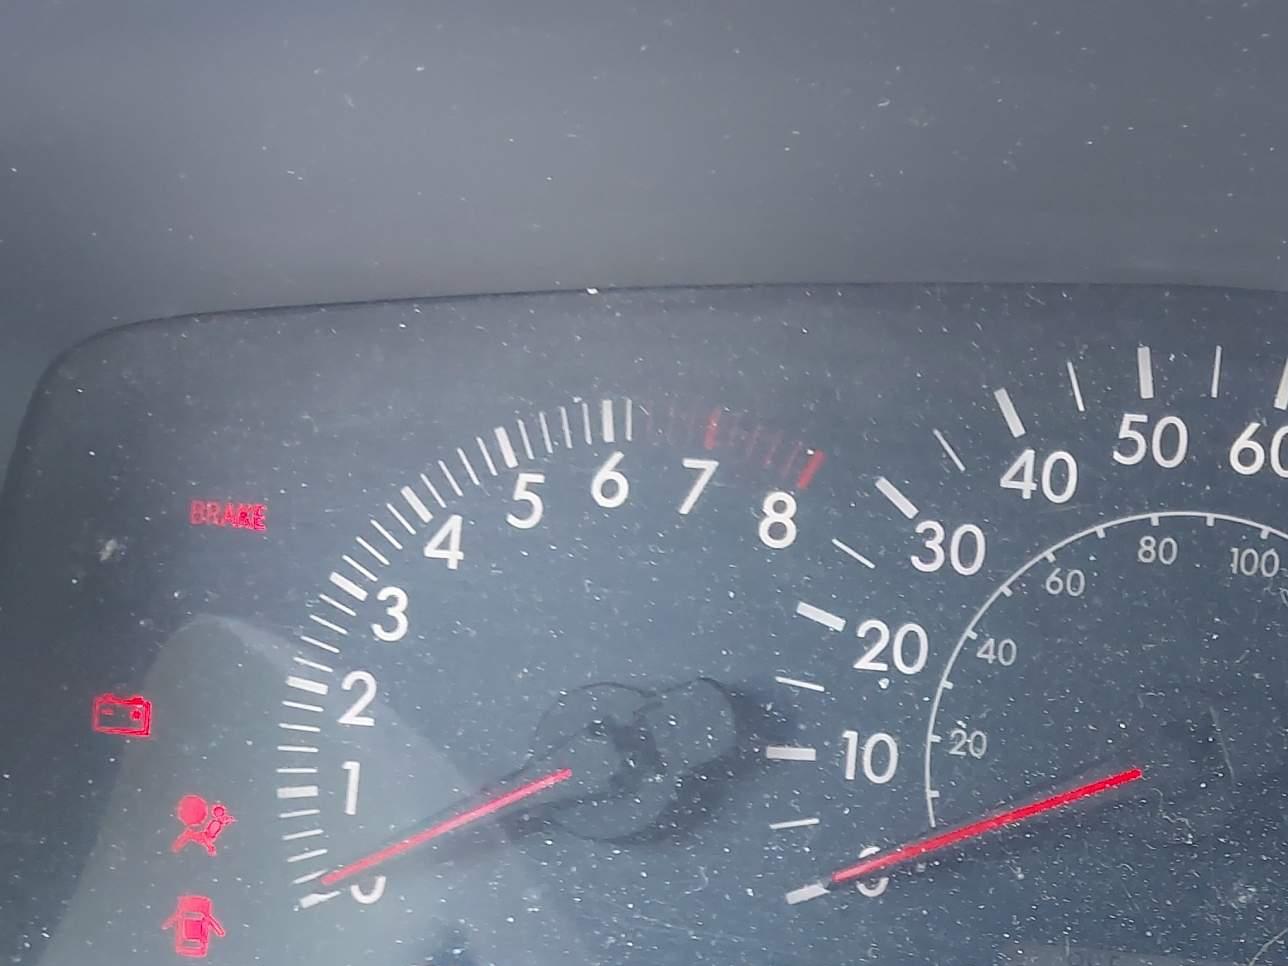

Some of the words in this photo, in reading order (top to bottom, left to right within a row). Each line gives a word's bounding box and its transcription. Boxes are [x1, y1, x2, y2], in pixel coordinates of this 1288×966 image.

[1113, 414, 1188, 469] 50
[506, 471, 546, 529] 5
[591, 449, 629, 508] 6
[678, 457, 719, 514] 7
[1000, 448, 1078, 504] 40
[190, 499, 268, 531] BRAKE
[424, 515, 464, 570] 4
[758, 490, 797, 549] 8
[911, 520, 985, 575] 30
[1137, 536, 1177, 566] 80
[1229, 547, 1280, 578] 100
[1045, 568, 1085, 597] 60
[371, 585, 409, 642] 3
[853, 620, 928, 674] 20
[977, 637, 1017, 666] 40
[338, 670, 376, 728] 2
[842, 731, 898, 784] 10
[951, 729, 987, 756] 20
[342, 761, 359, 815] 1
